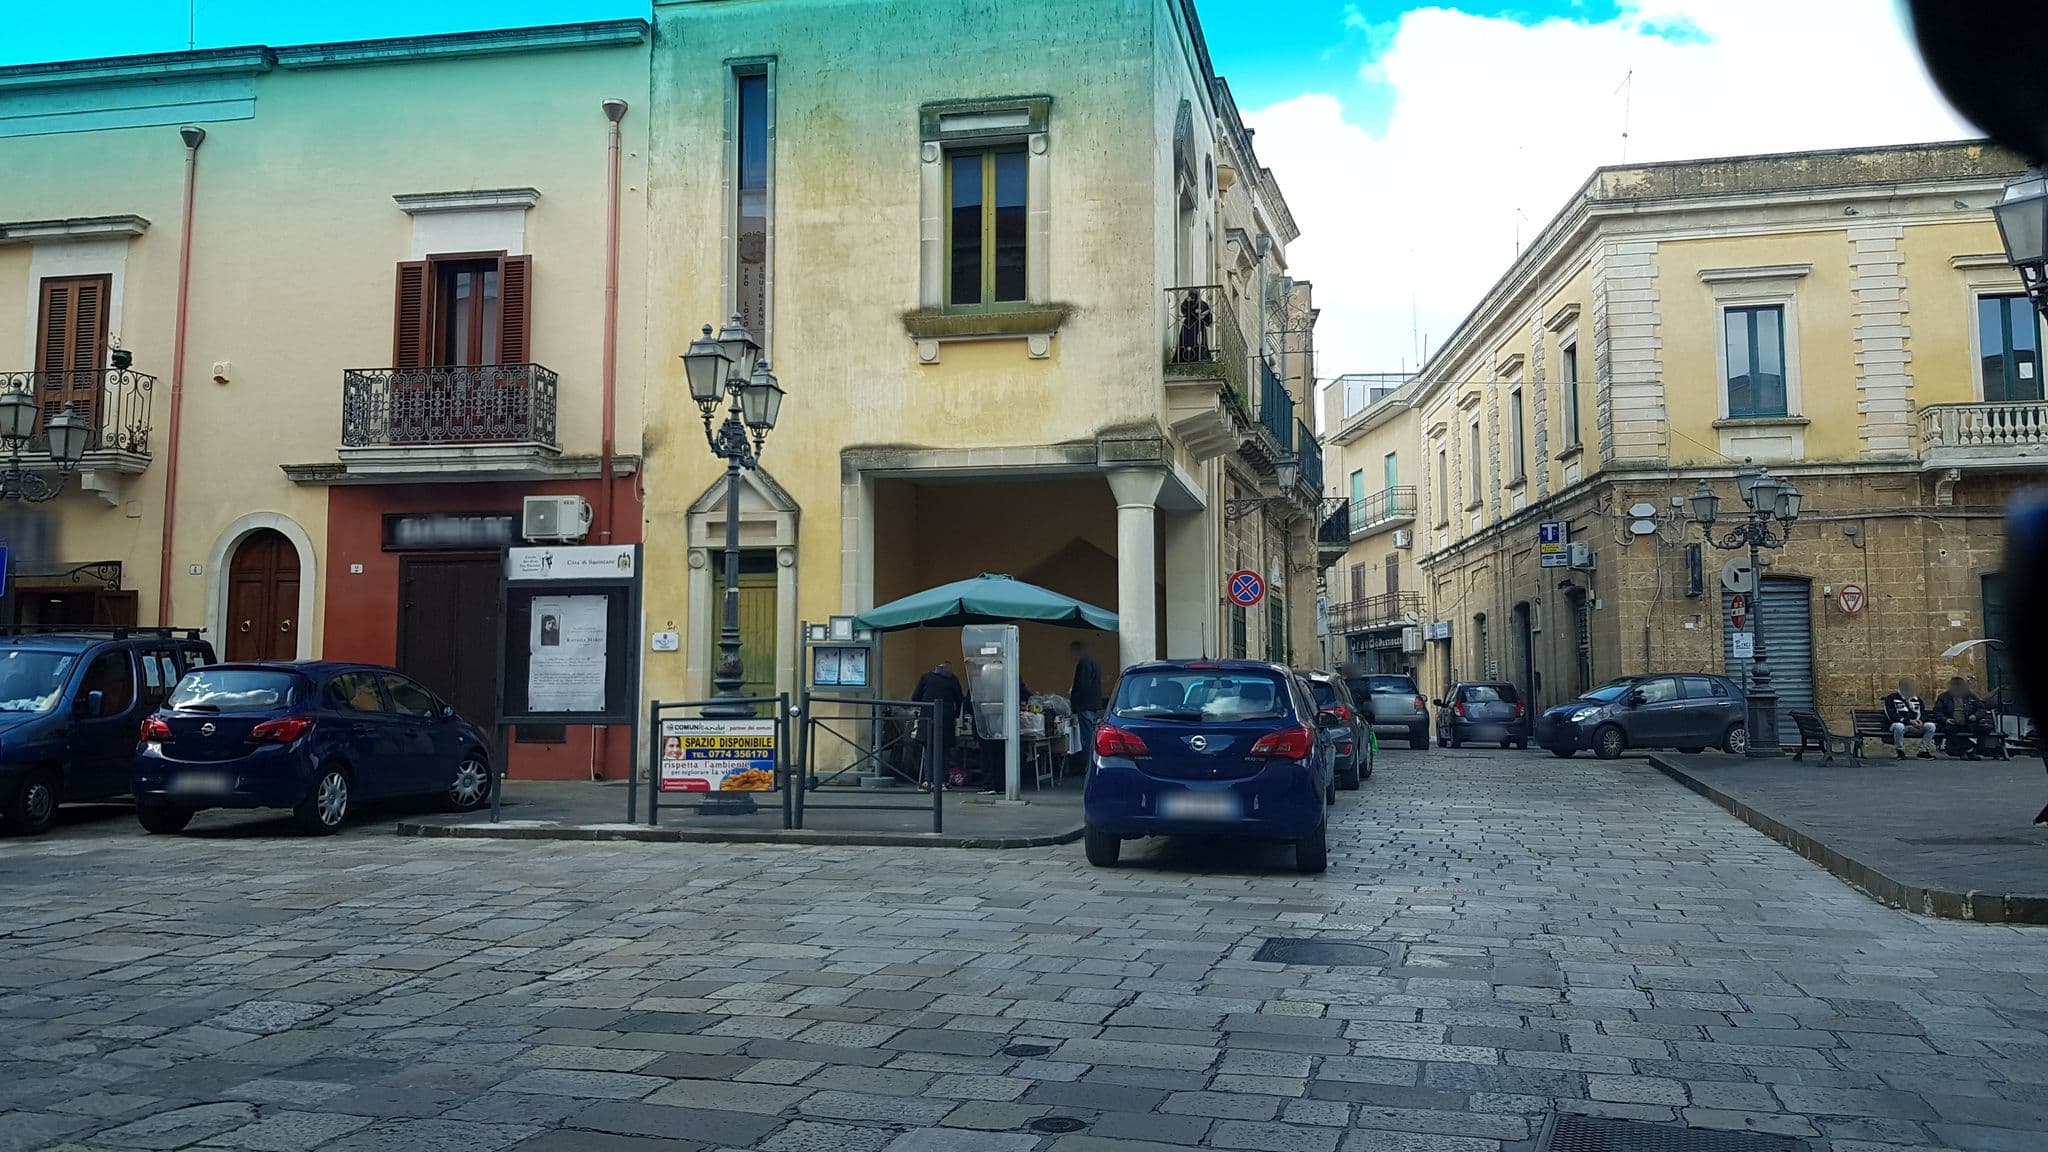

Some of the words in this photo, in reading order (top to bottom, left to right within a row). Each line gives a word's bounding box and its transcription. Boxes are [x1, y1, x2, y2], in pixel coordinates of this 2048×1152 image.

[685, 737, 716, 748] SPAZIO
[719, 737, 772, 748] DISPONIBILE
[708, 750, 732, 759] 0774
[734, 749, 769, 758] 356170
[664, 761, 699, 770] rispetta
[705, 760, 751, 769] l'ambiente
